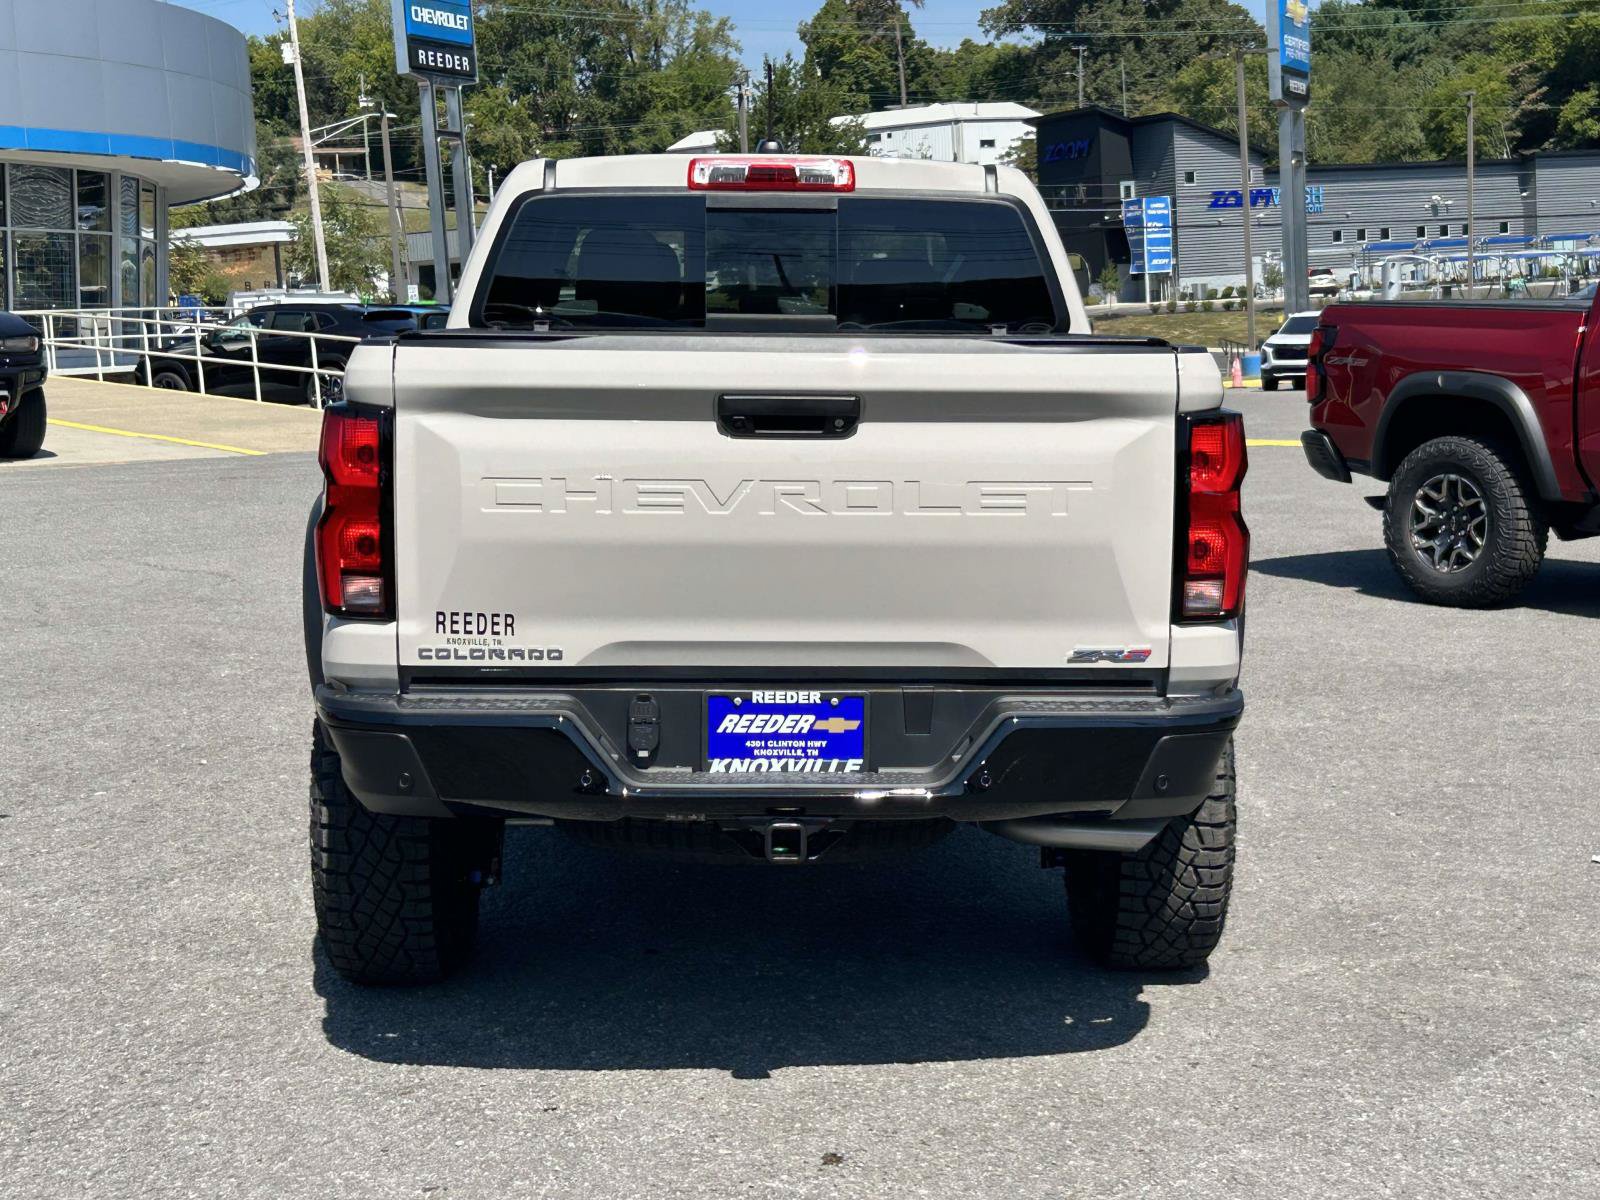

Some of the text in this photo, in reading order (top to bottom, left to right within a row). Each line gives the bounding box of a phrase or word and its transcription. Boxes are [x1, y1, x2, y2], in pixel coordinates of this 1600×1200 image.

[411, 6, 468, 30] CHEVROLET
[418, 49, 470, 71] REEDER
[1043, 140, 1089, 161] ZOOM
[480, 474, 1094, 516] CHEVROLET
[435, 611, 515, 636] REEDER
[446, 637, 490, 647] KNOXVILLE,
[418, 648, 563, 660] COLORADO
[752, 691, 821, 704] REEDER
[716, 714, 816, 733] REEDER
[767, 740, 806, 748] CLINTON
[808, 740, 828, 748] HWY
